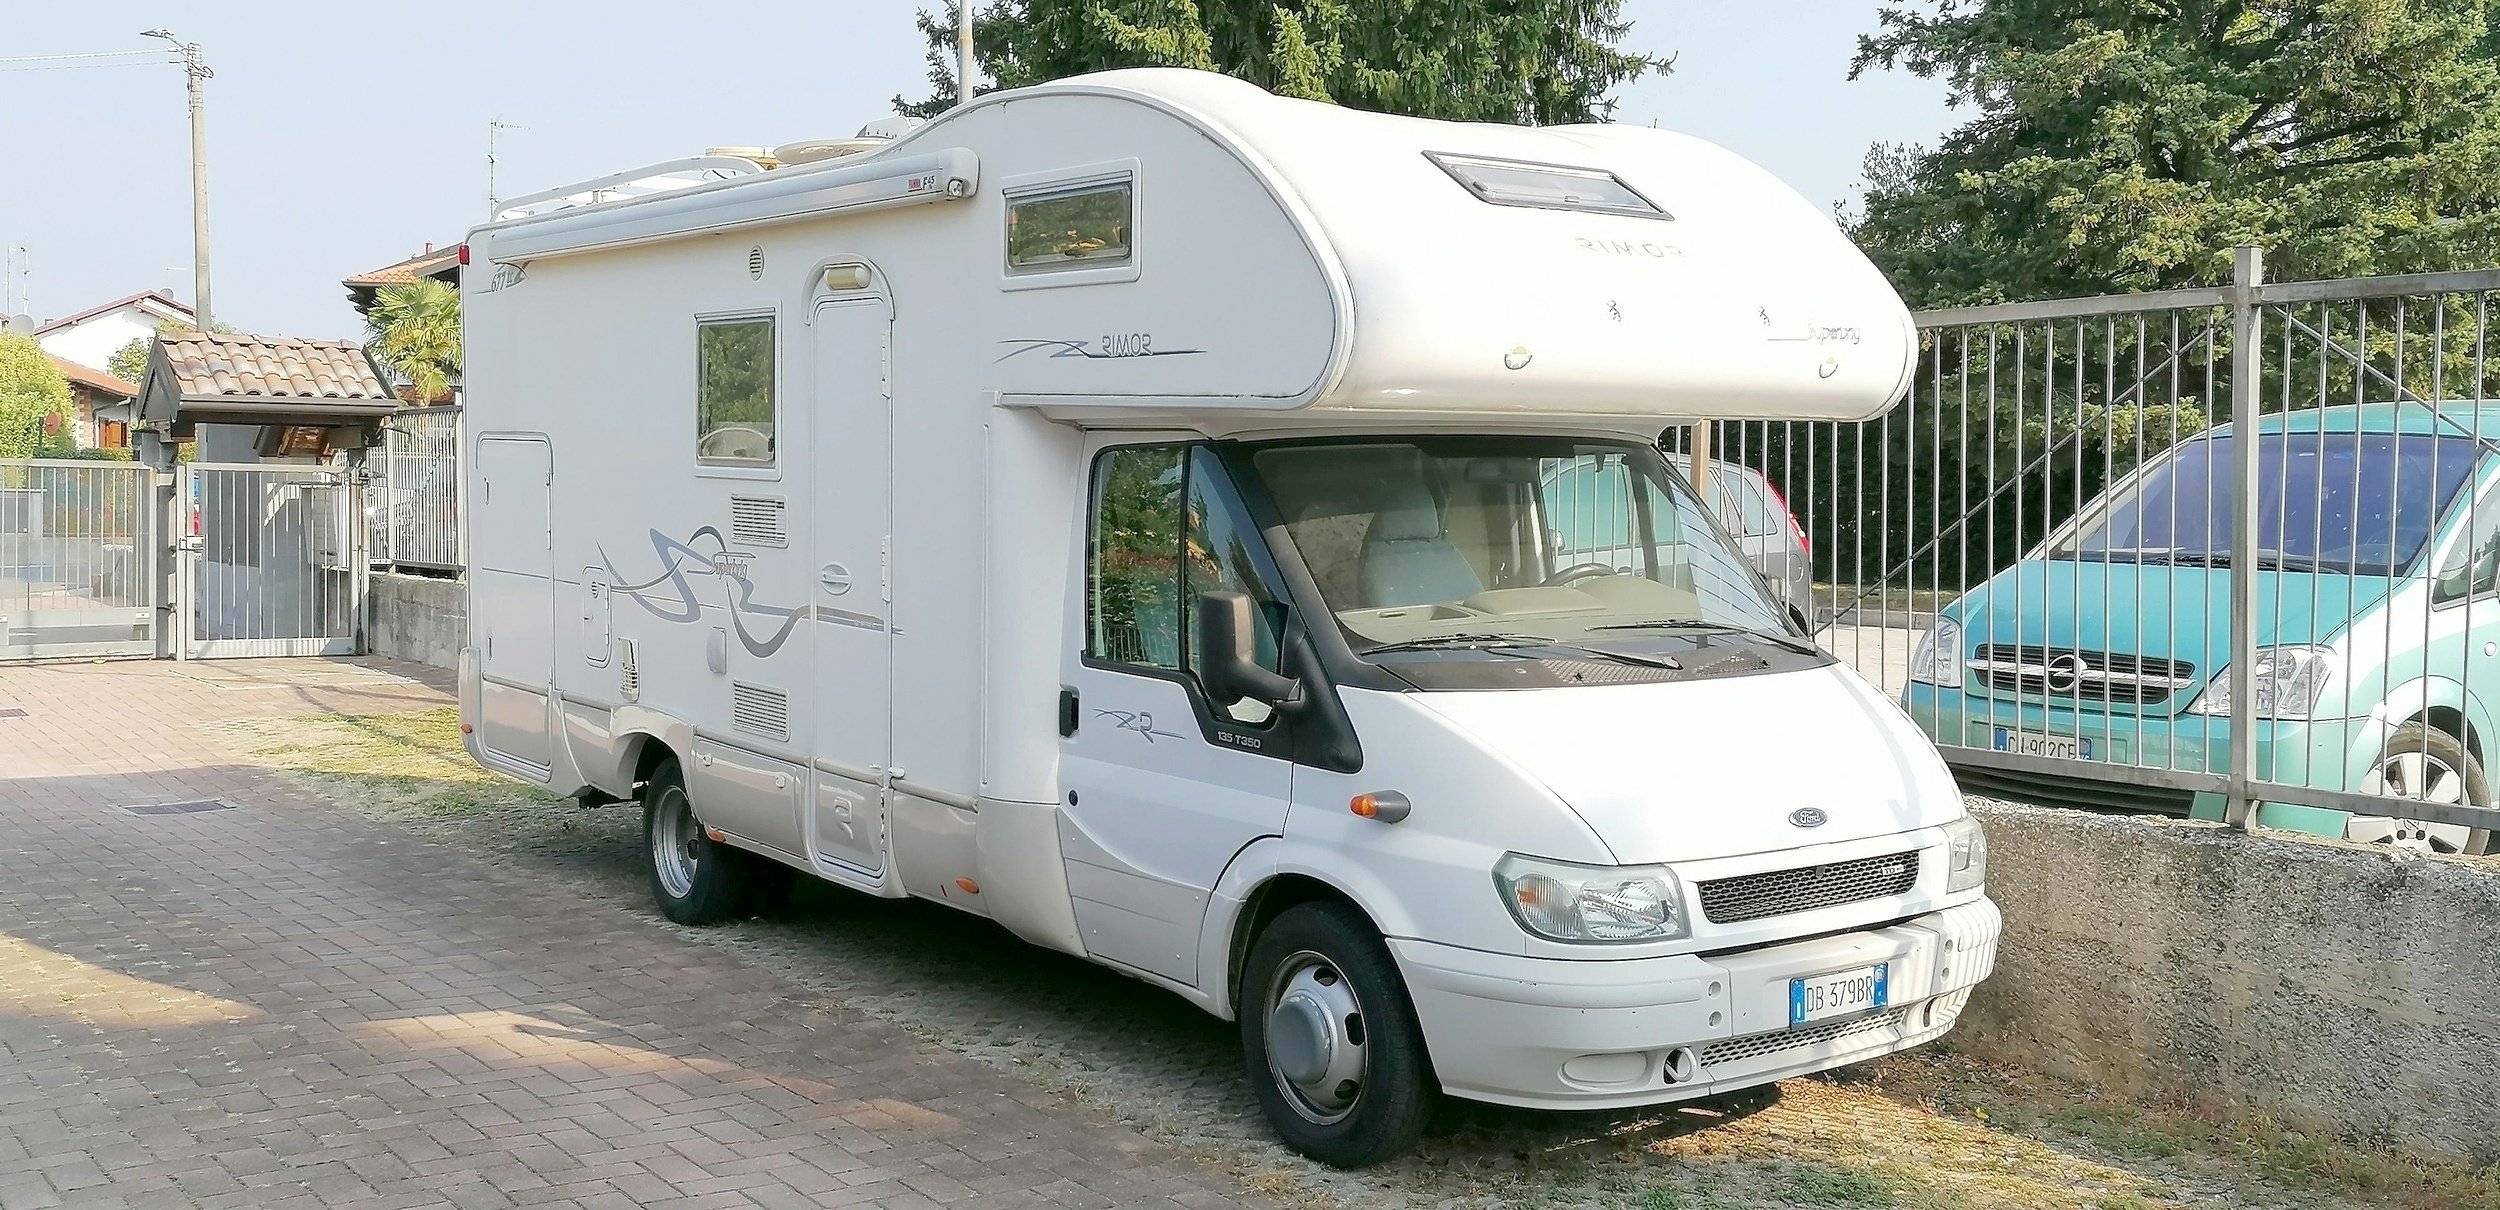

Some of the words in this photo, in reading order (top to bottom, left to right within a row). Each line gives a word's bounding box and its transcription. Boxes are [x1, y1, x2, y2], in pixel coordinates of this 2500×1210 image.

[1102, 333, 1153, 357] RIMOR
[1218, 731, 1233, 743] 135
[1235, 733, 1261, 749] T350
[1799, 810, 1822, 824] Ford
[1806, 985, 1824, 1013] DB
[1829, 975, 1873, 1008] 379BR
